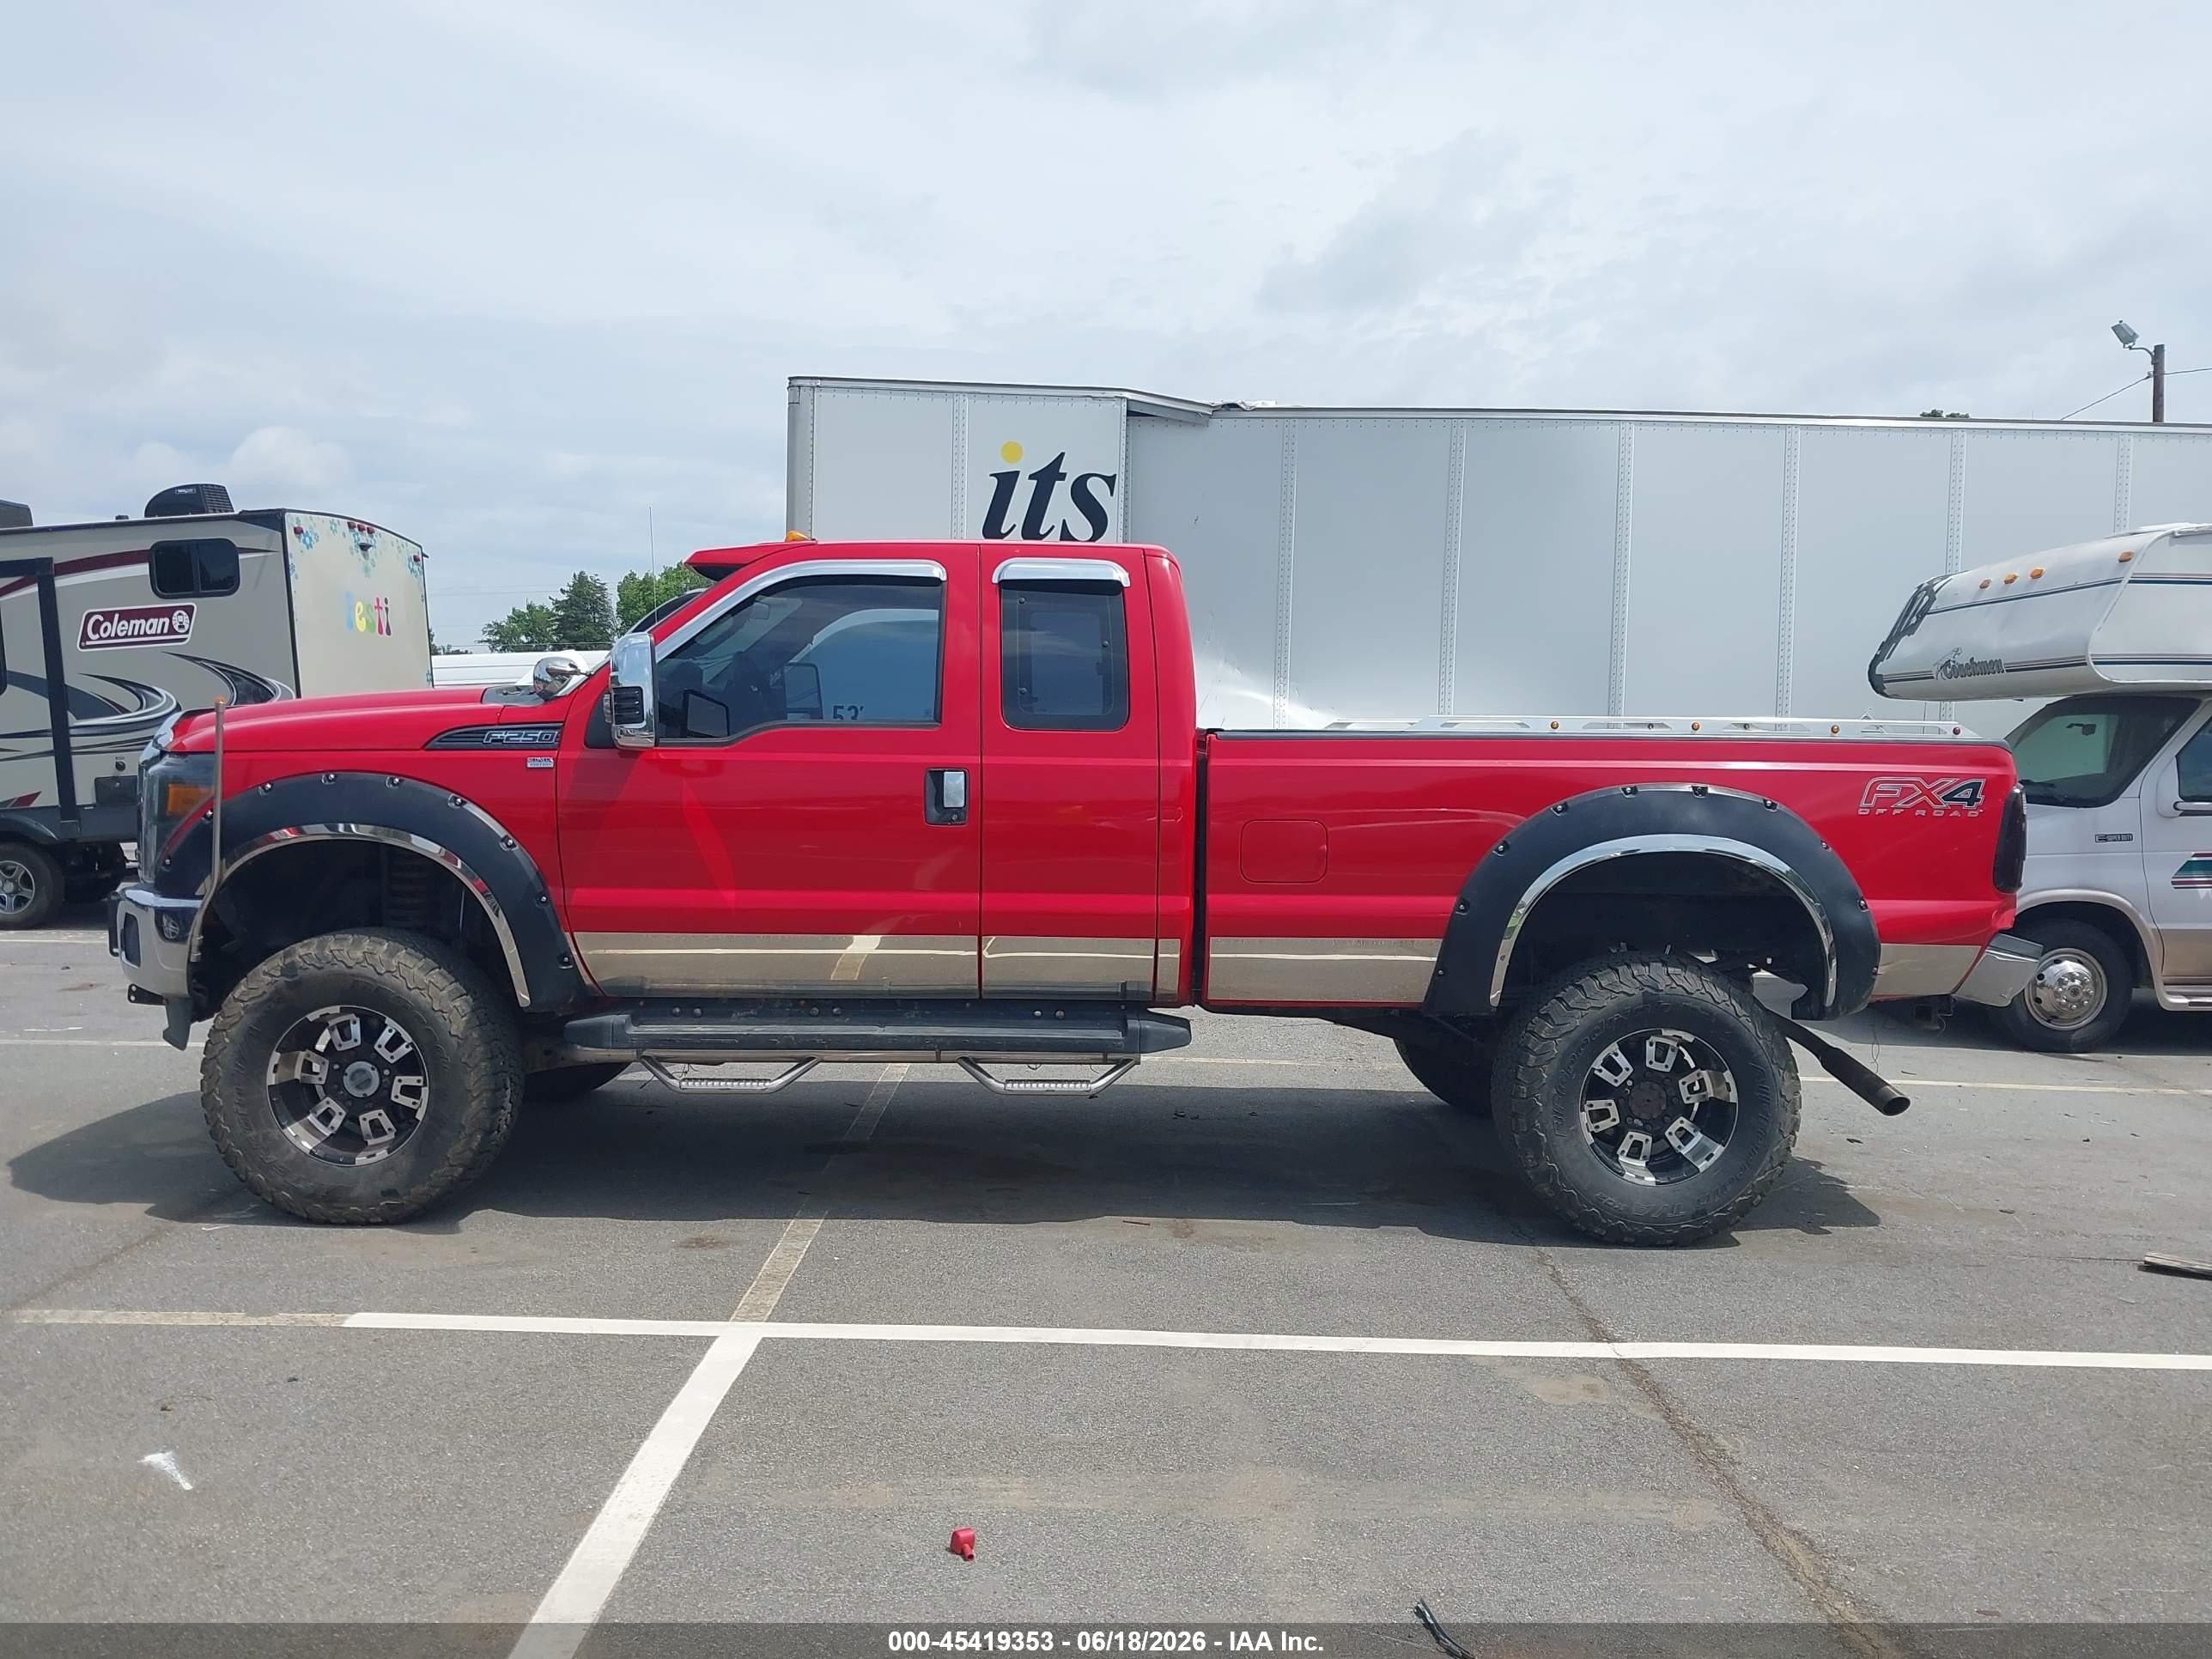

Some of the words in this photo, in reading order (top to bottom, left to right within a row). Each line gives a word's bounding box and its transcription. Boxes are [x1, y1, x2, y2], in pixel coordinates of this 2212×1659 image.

[982, 441, 1117, 541] its
[87, 613, 170, 640] Coleman
[1860, 776, 1986, 810] FX4
